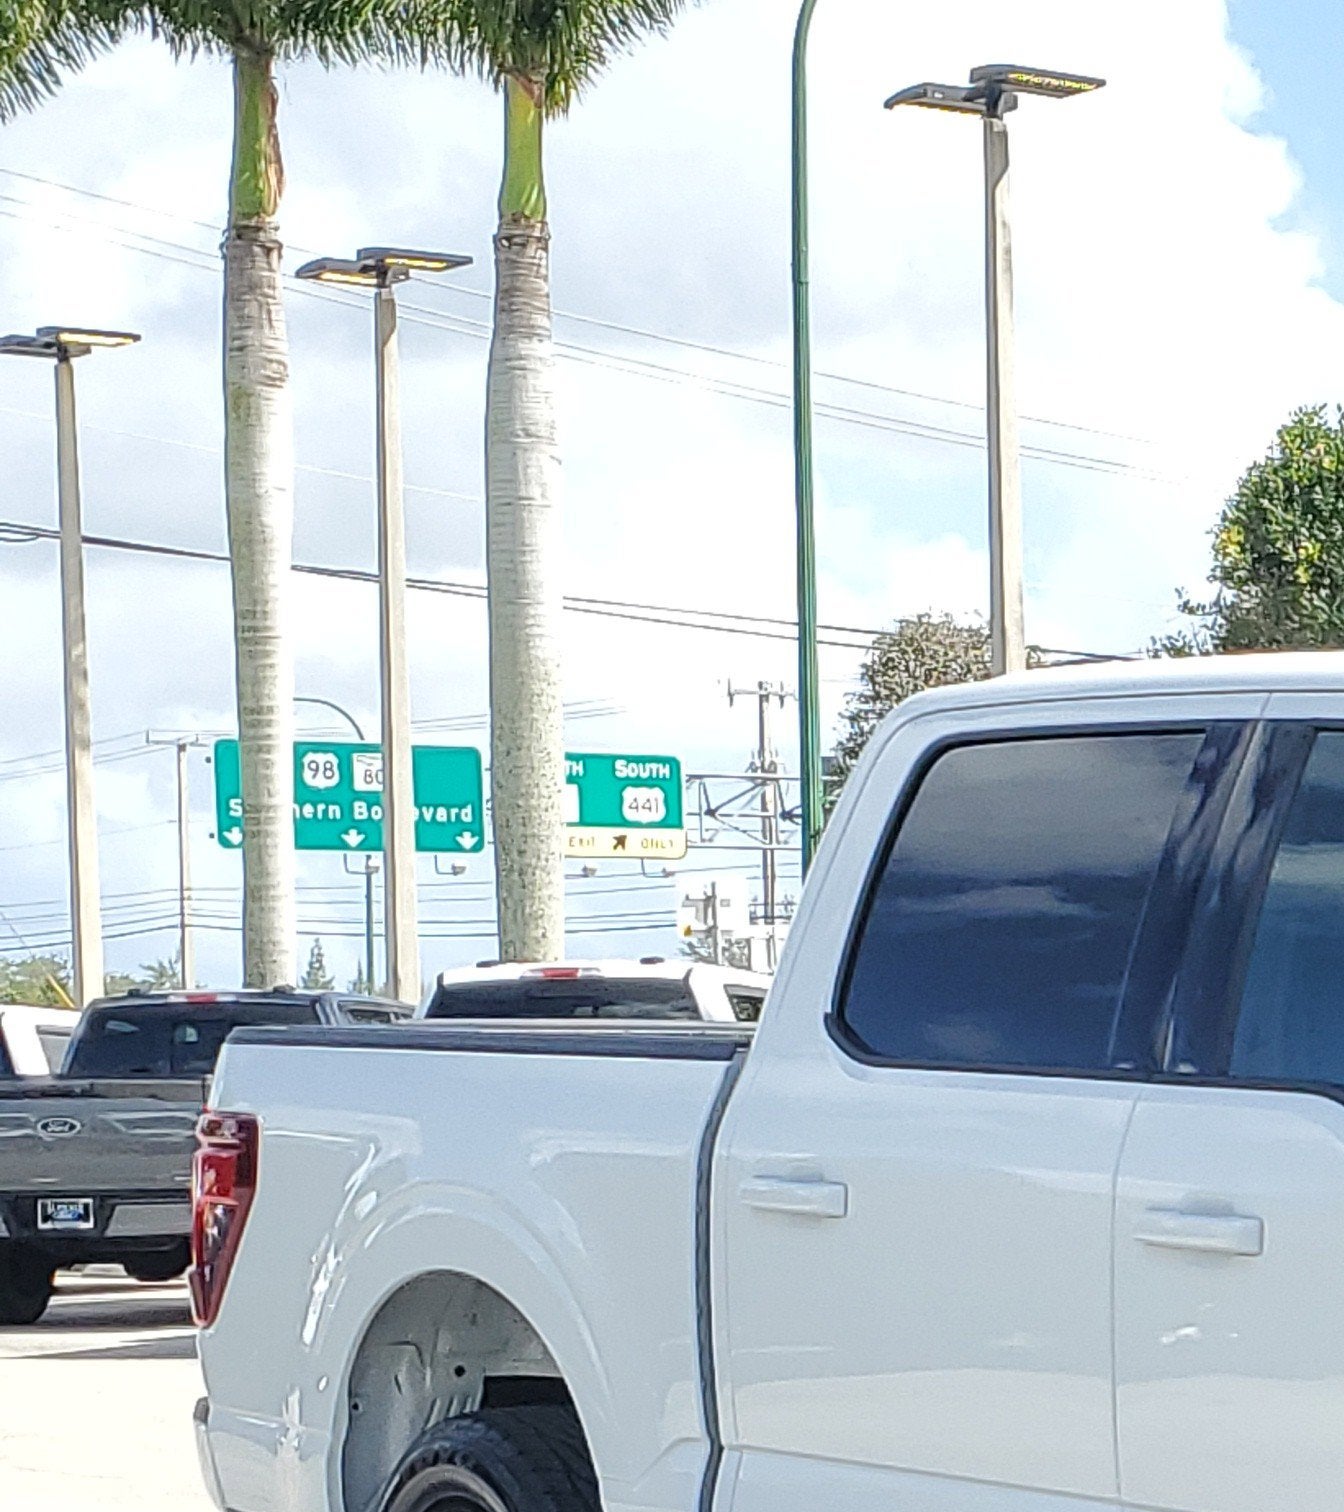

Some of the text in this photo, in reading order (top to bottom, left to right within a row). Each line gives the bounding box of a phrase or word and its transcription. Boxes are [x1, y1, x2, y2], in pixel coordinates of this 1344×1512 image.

[306, 760, 336, 780] 98
[614, 759, 671, 779] SOUTH
[628, 797, 660, 815] 441
